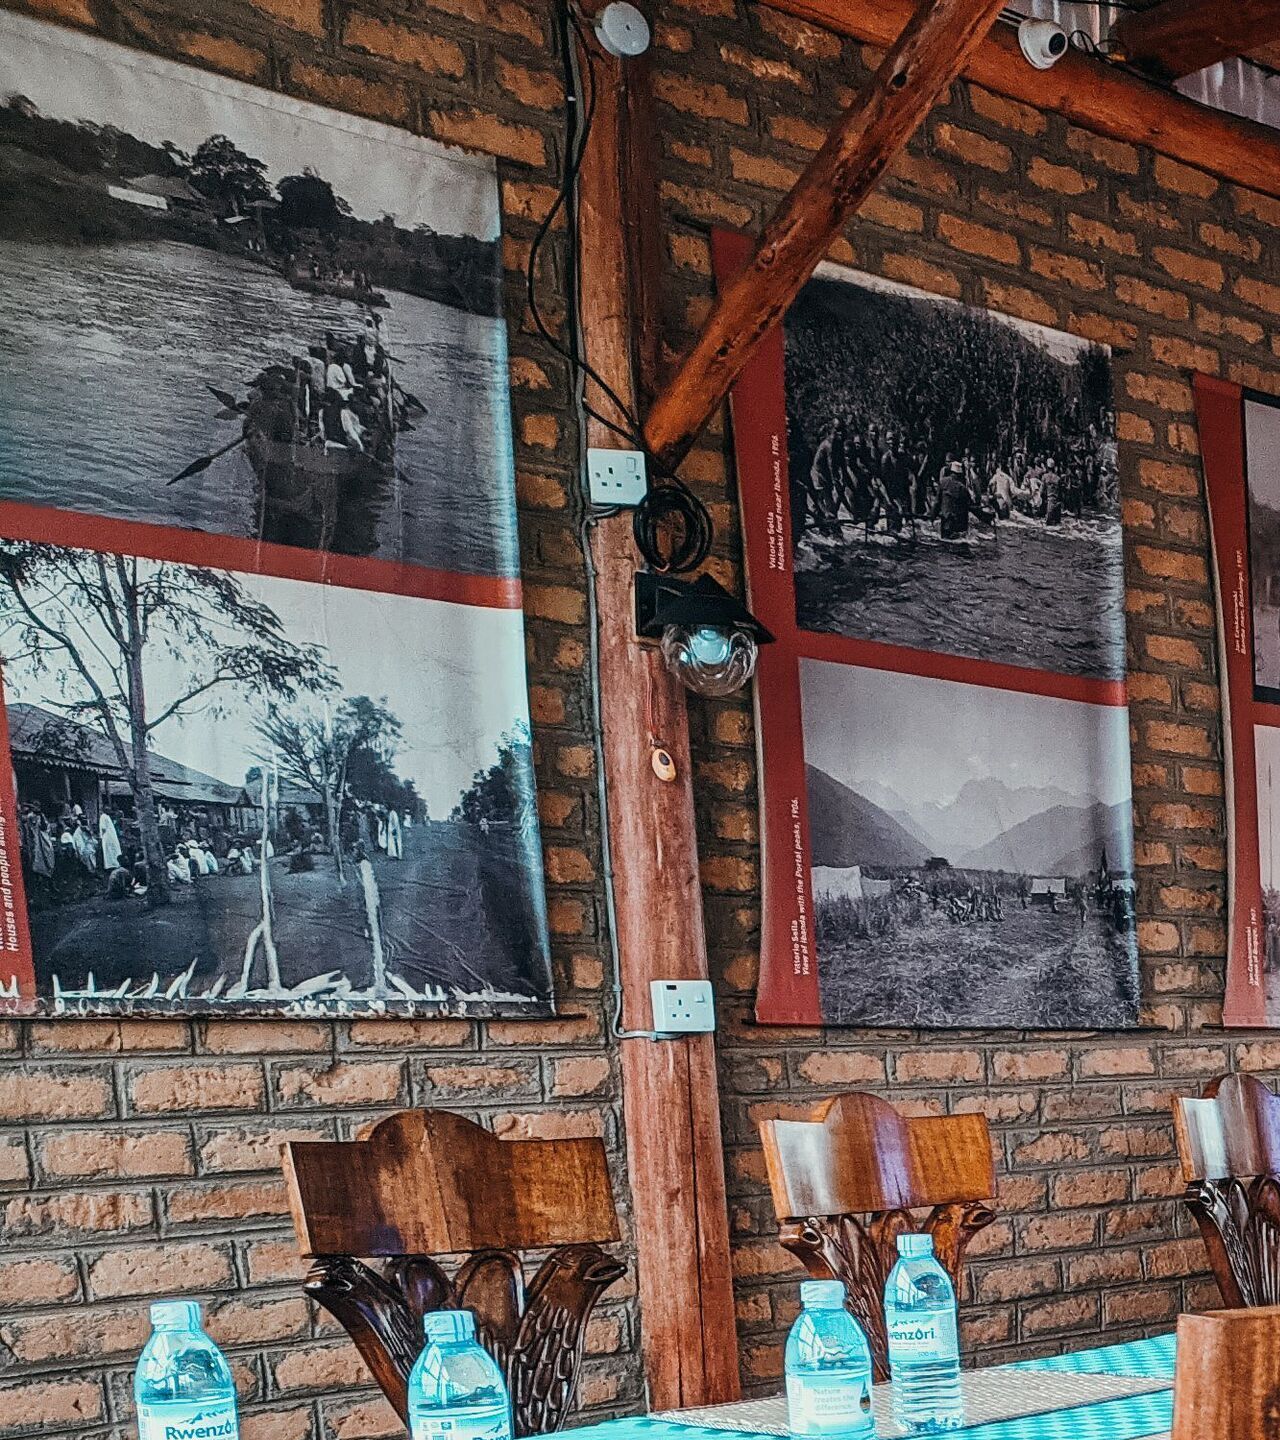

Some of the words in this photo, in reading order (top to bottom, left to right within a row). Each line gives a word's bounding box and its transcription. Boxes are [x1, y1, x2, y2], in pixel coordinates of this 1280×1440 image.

[0, 849, 12, 886] people
[795, 851, 803, 878] Portal
[1, 886, 13, 909] and
[796, 879, 804, 894] the
[797, 894, 805, 914] with
[5, 911, 19, 951] Houses
[791, 919, 799, 942] Sella
[792, 942, 801, 975] Vittorio
[800, 944, 808, 954] of
[801, 954, 810, 976] View
